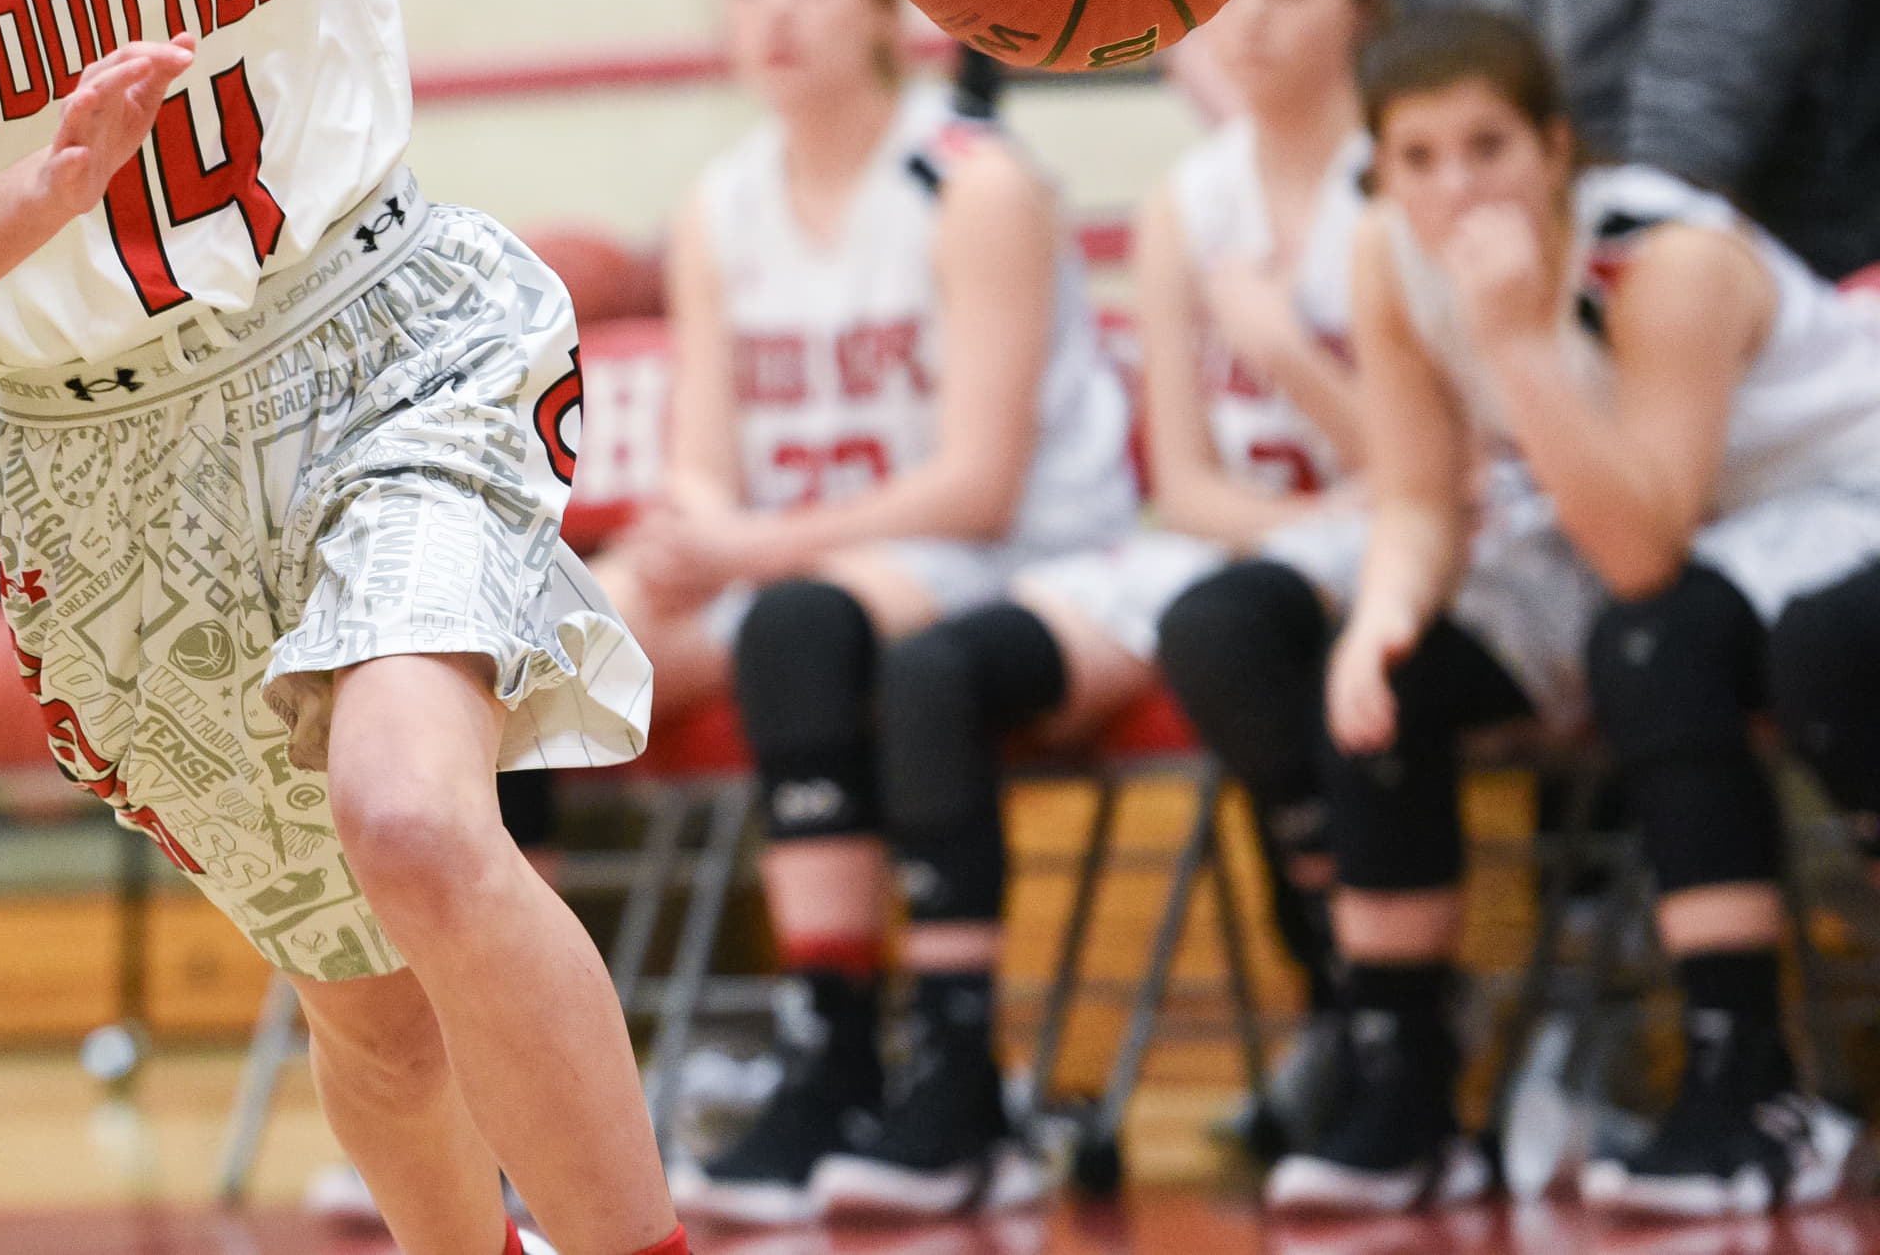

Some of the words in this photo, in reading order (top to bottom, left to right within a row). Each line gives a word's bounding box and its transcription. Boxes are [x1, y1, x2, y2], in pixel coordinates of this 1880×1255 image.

[102, 56, 287, 318] 14
[46, 629, 271, 890] TOUNESS
[134, 713, 228, 794] FENSE
[142, 664, 208, 721] WIN
[192, 714, 265, 786] TRADITION
